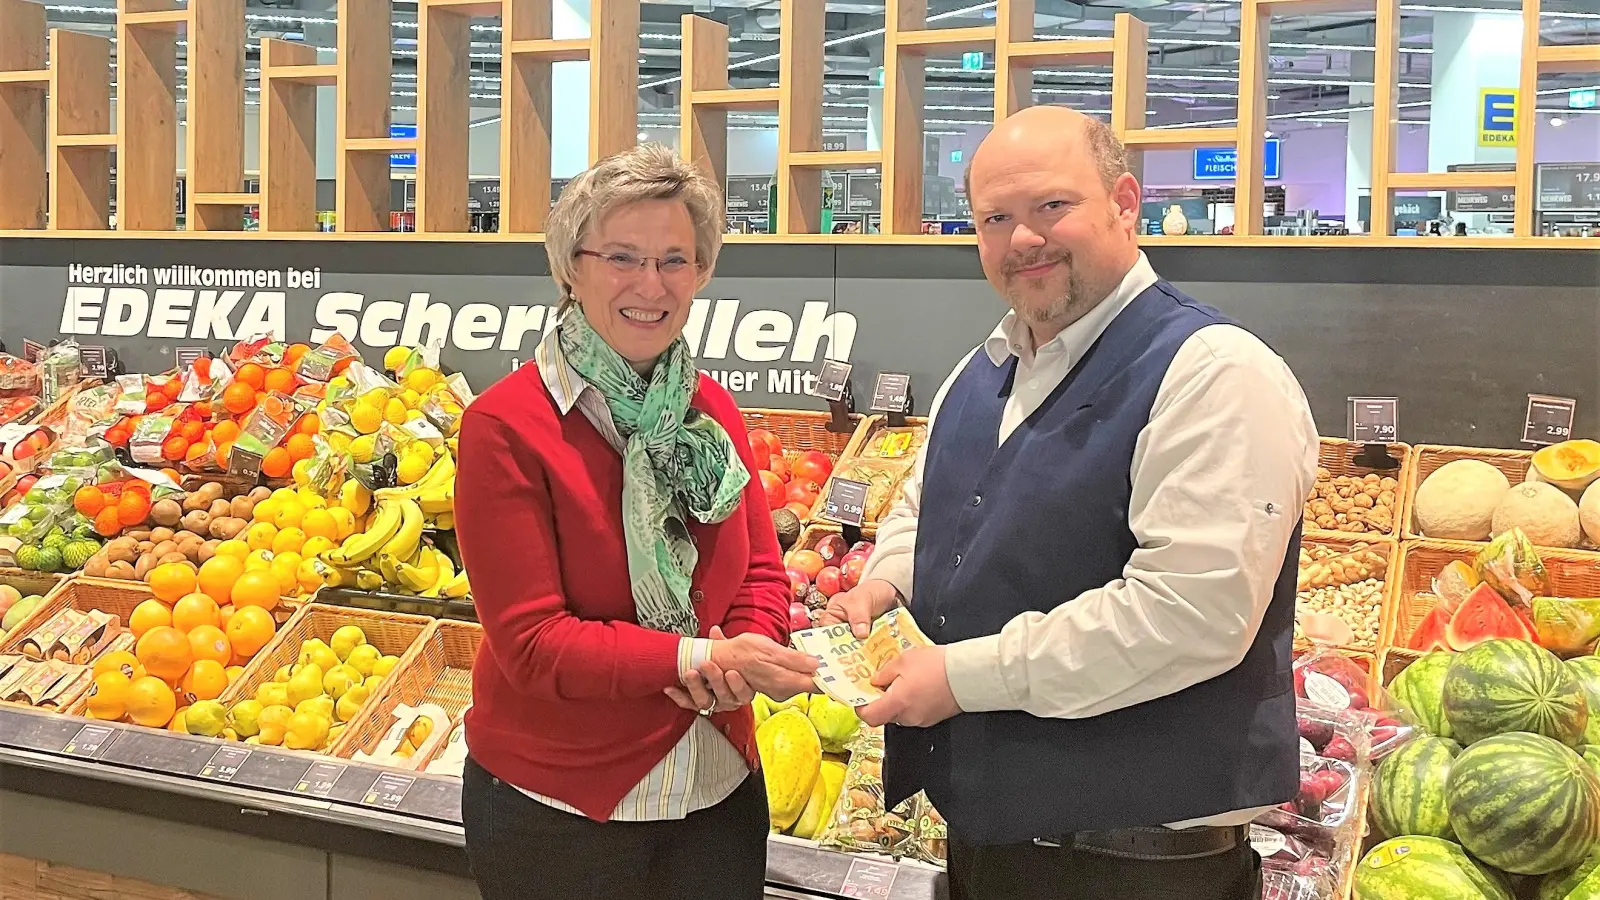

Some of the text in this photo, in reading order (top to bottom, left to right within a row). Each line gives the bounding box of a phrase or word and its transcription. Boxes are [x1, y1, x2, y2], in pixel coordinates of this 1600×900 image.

[1482, 134, 1515, 142] EDEKA
[823, 142, 845, 151] 18.99
[750, 183, 769, 191] 13.4
[68, 263, 321, 289] Herzlich willkommen bei
[59, 286, 286, 342] EDEKA
[767, 367, 819, 396] Mit
[1373, 425, 1395, 434] 7.90
[1546, 425, 1569, 436] 2.99
[843, 503, 862, 515] 0.99
[843, 663, 873, 684] 50
